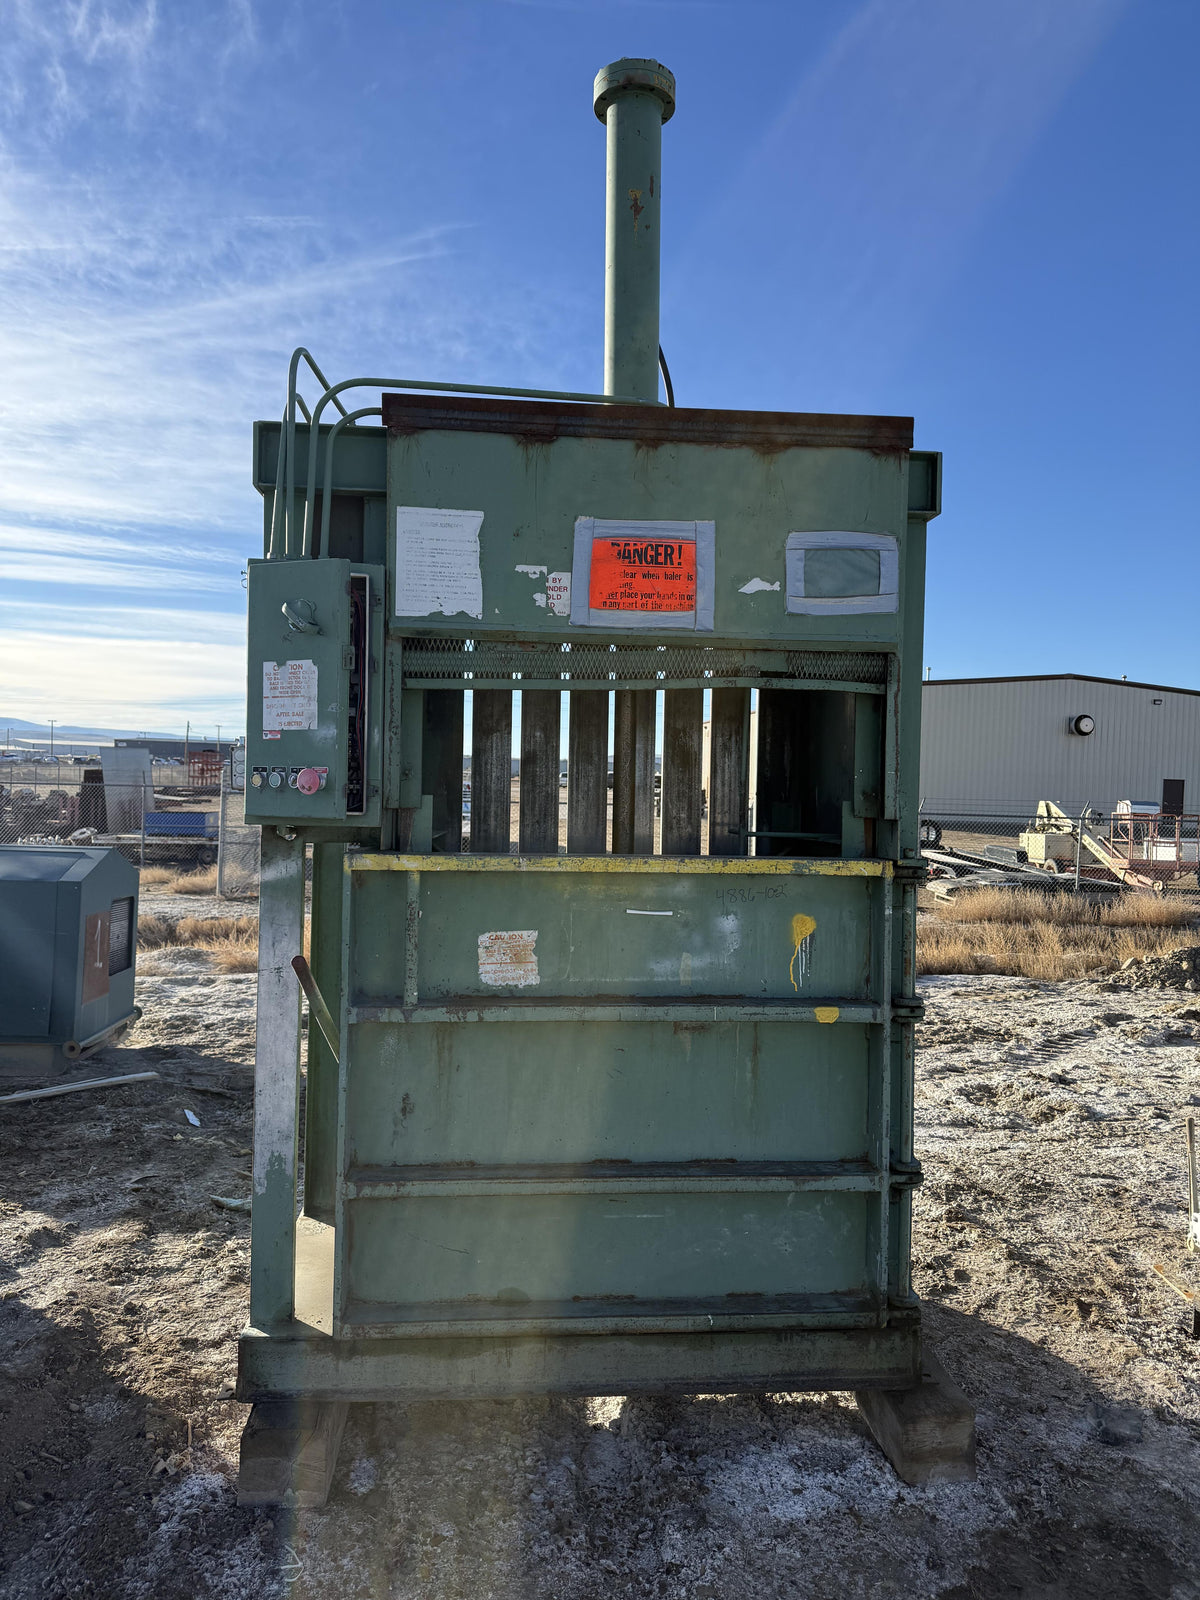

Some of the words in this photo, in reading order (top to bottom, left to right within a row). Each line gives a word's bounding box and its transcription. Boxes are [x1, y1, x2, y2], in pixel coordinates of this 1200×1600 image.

[621, 569, 637, 579] lear
[664, 571, 682, 581] baler
[687, 572, 693, 581] is
[620, 590, 639, 599] place
[640, 592, 656, 600] your
[678, 592, 685, 600] in
[608, 600, 620, 609] any
[640, 600, 648, 609] of
[651, 600, 663, 609] the
